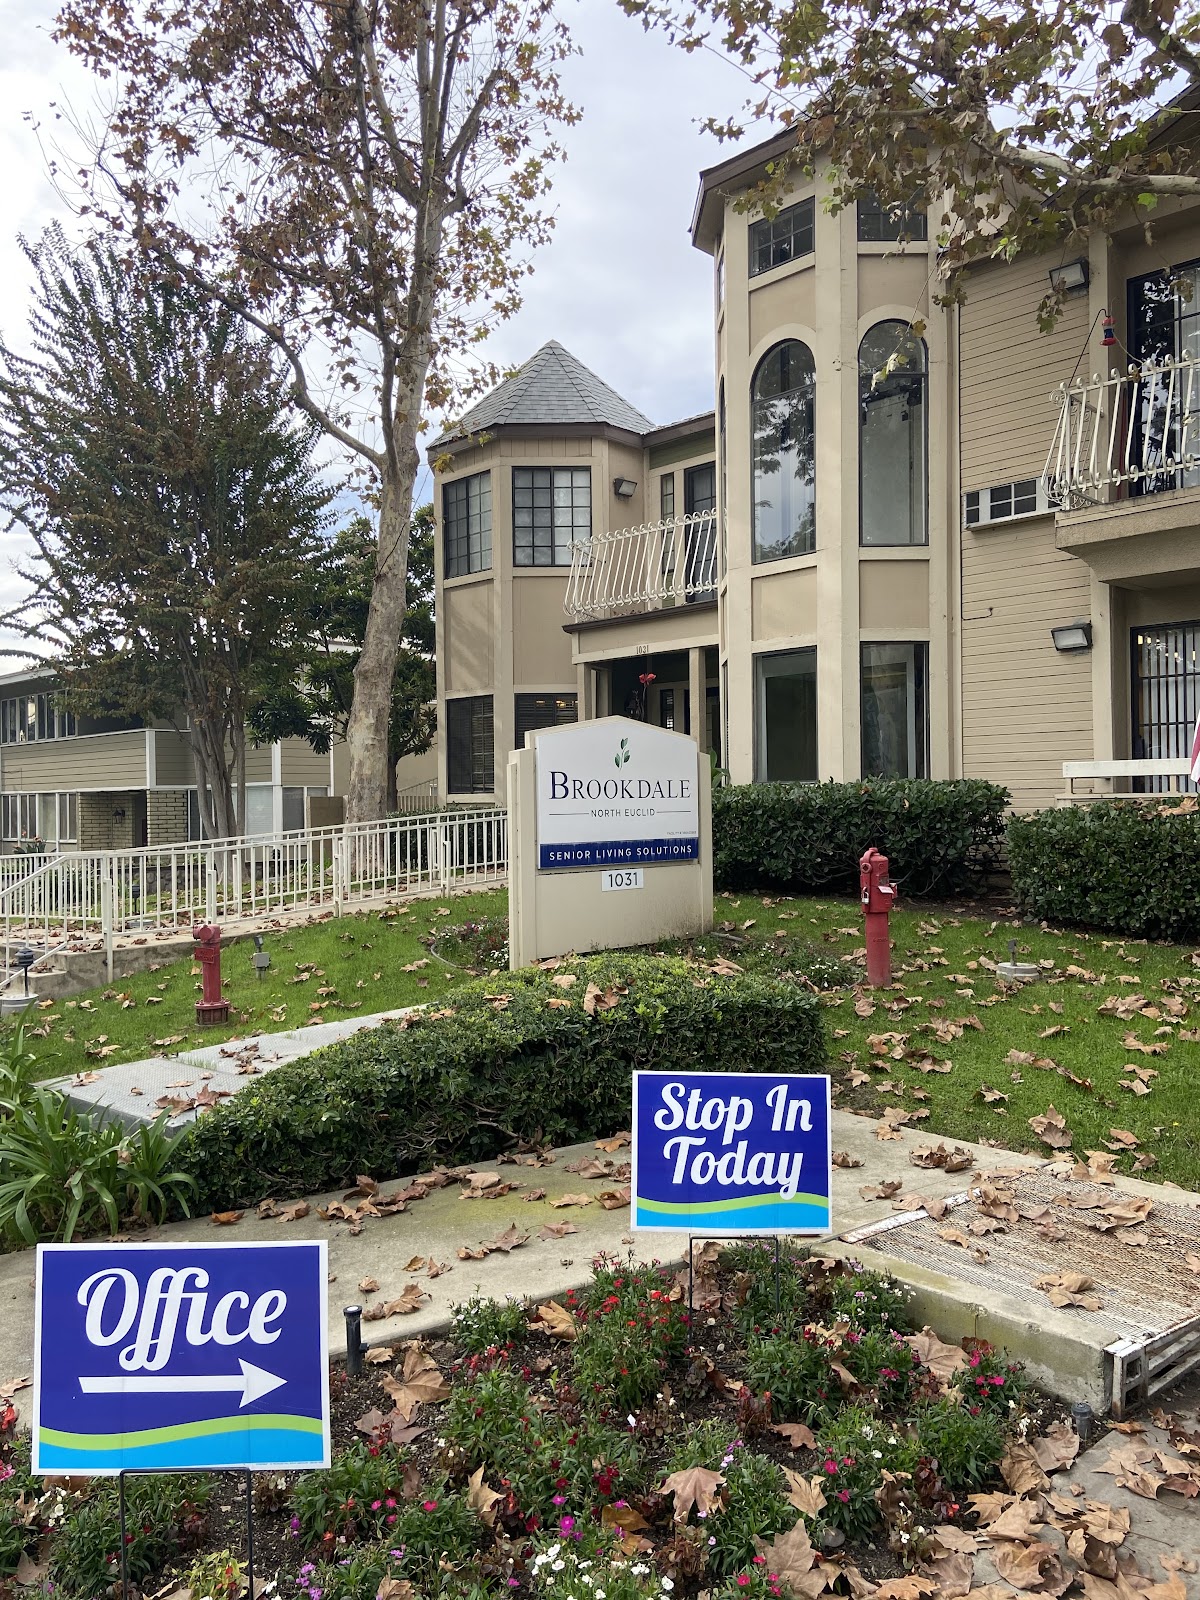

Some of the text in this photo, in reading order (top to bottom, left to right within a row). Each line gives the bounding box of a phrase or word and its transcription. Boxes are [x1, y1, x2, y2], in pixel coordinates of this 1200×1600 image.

[636, 645, 649, 654] 1031
[549, 771, 691, 800] BROOKDALE
[591, 808, 656, 818] NORTH EUCLID
[549, 845, 692, 861] SENIOR LIVING SOLUTIONS
[608, 872, 638, 887] 1031
[653, 1082, 813, 1146] Stop In
[663, 1136, 803, 1200] Today
[77, 1267, 287, 1371] Office
